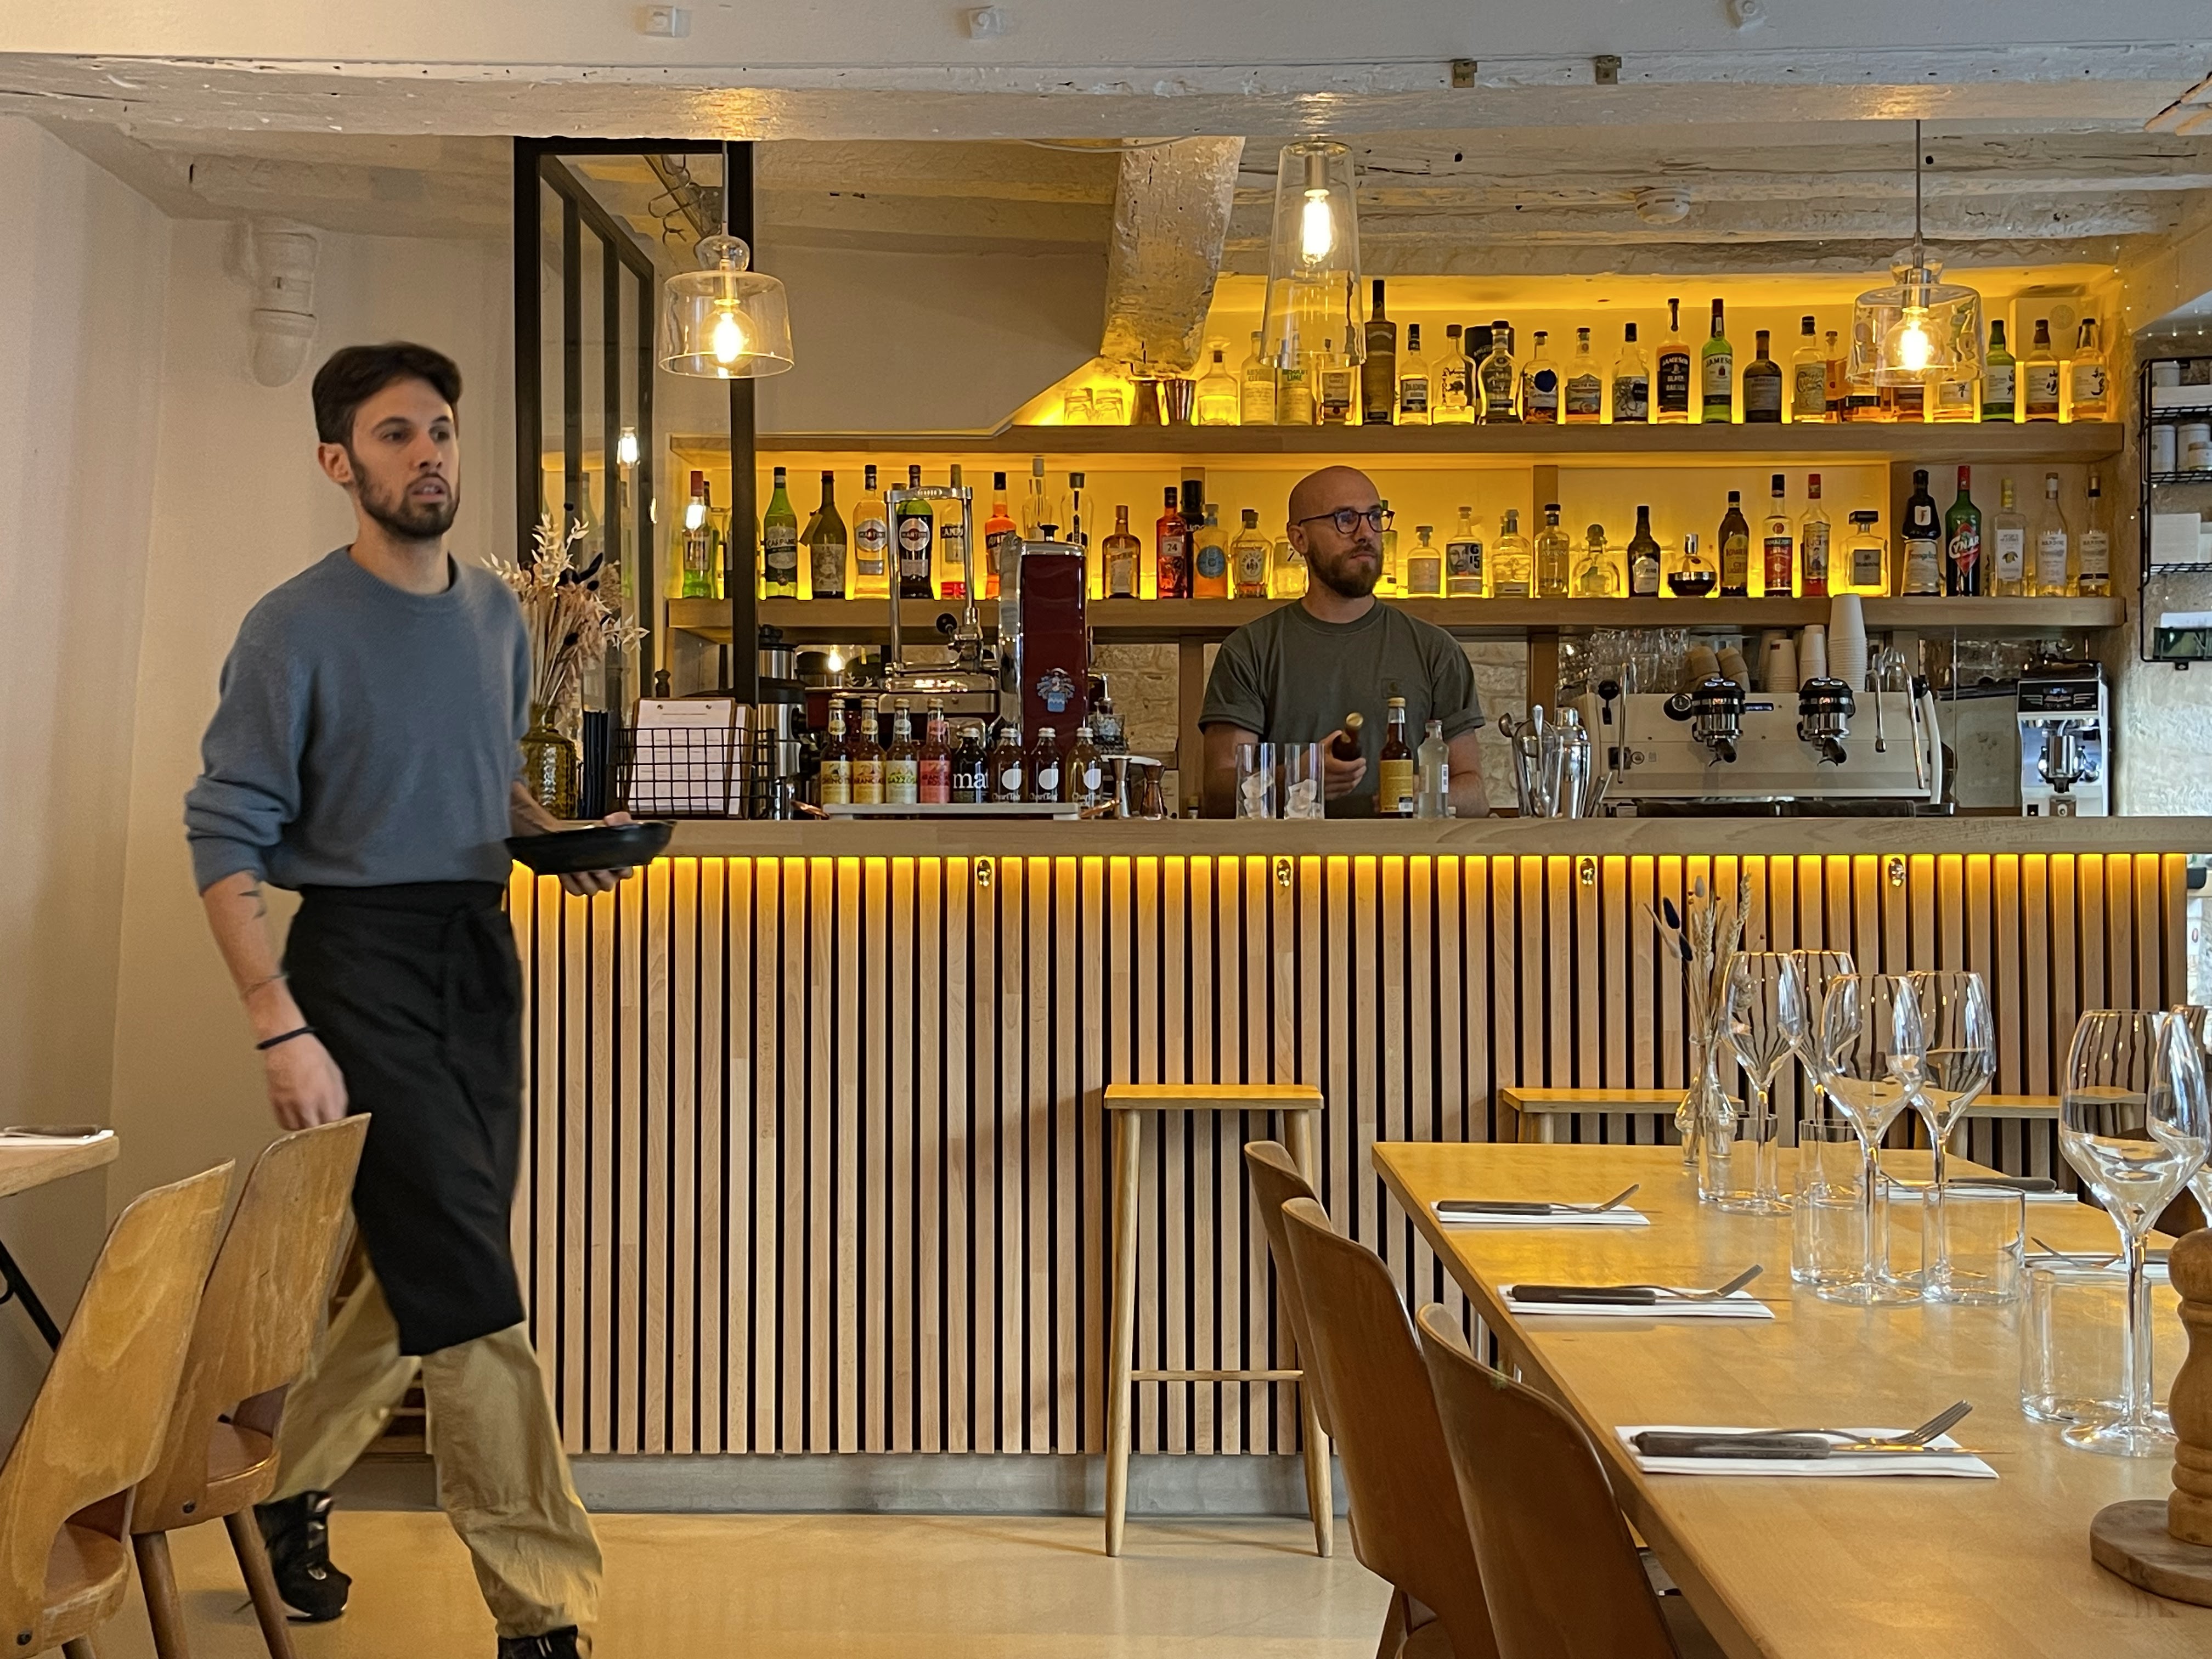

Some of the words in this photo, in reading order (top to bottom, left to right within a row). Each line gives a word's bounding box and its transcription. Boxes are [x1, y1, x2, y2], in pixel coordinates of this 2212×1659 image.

[1167, 543, 1178, 551] 24
[1465, 544, 1479, 555] 16
[1948, 535, 1979, 559] CYNAR
[1470, 556, 1480, 568] 15
